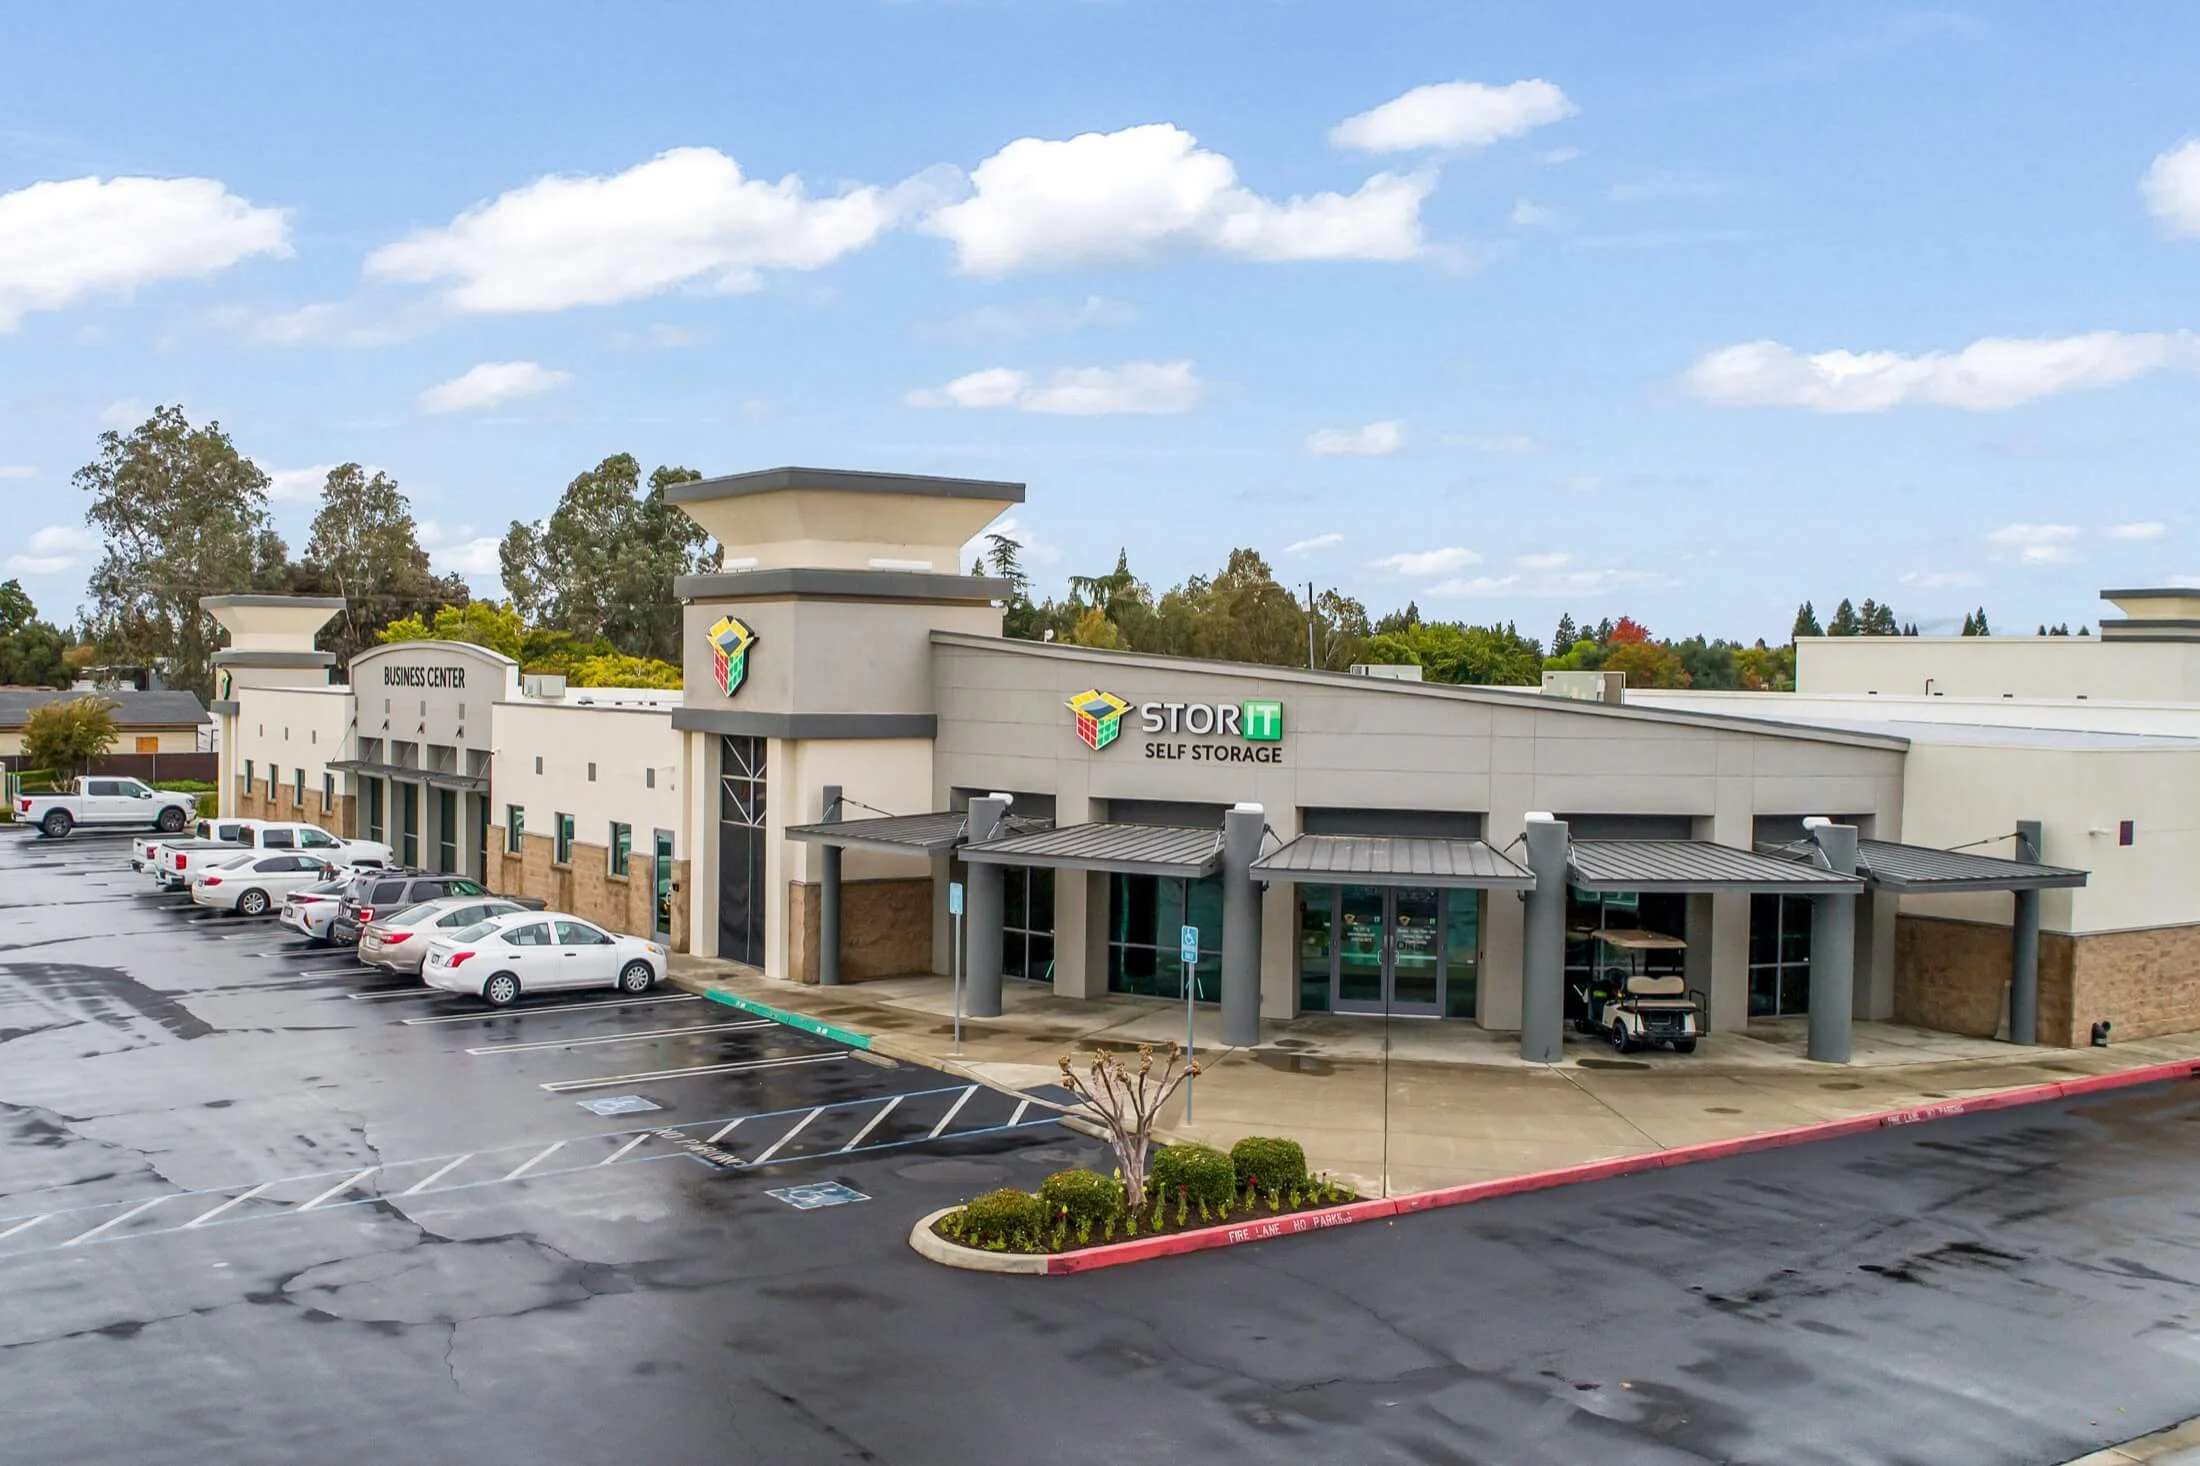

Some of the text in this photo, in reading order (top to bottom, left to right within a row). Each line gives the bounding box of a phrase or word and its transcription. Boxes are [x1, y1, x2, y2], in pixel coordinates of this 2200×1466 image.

[384, 666, 465, 688] BUSINESS CENTER
[1145, 743, 1283, 764] SELF STORAGE
[1229, 1229, 1249, 1243] FIRE
[1256, 1223, 1281, 1239] LANE
[1293, 1219, 1307, 1232] NO
